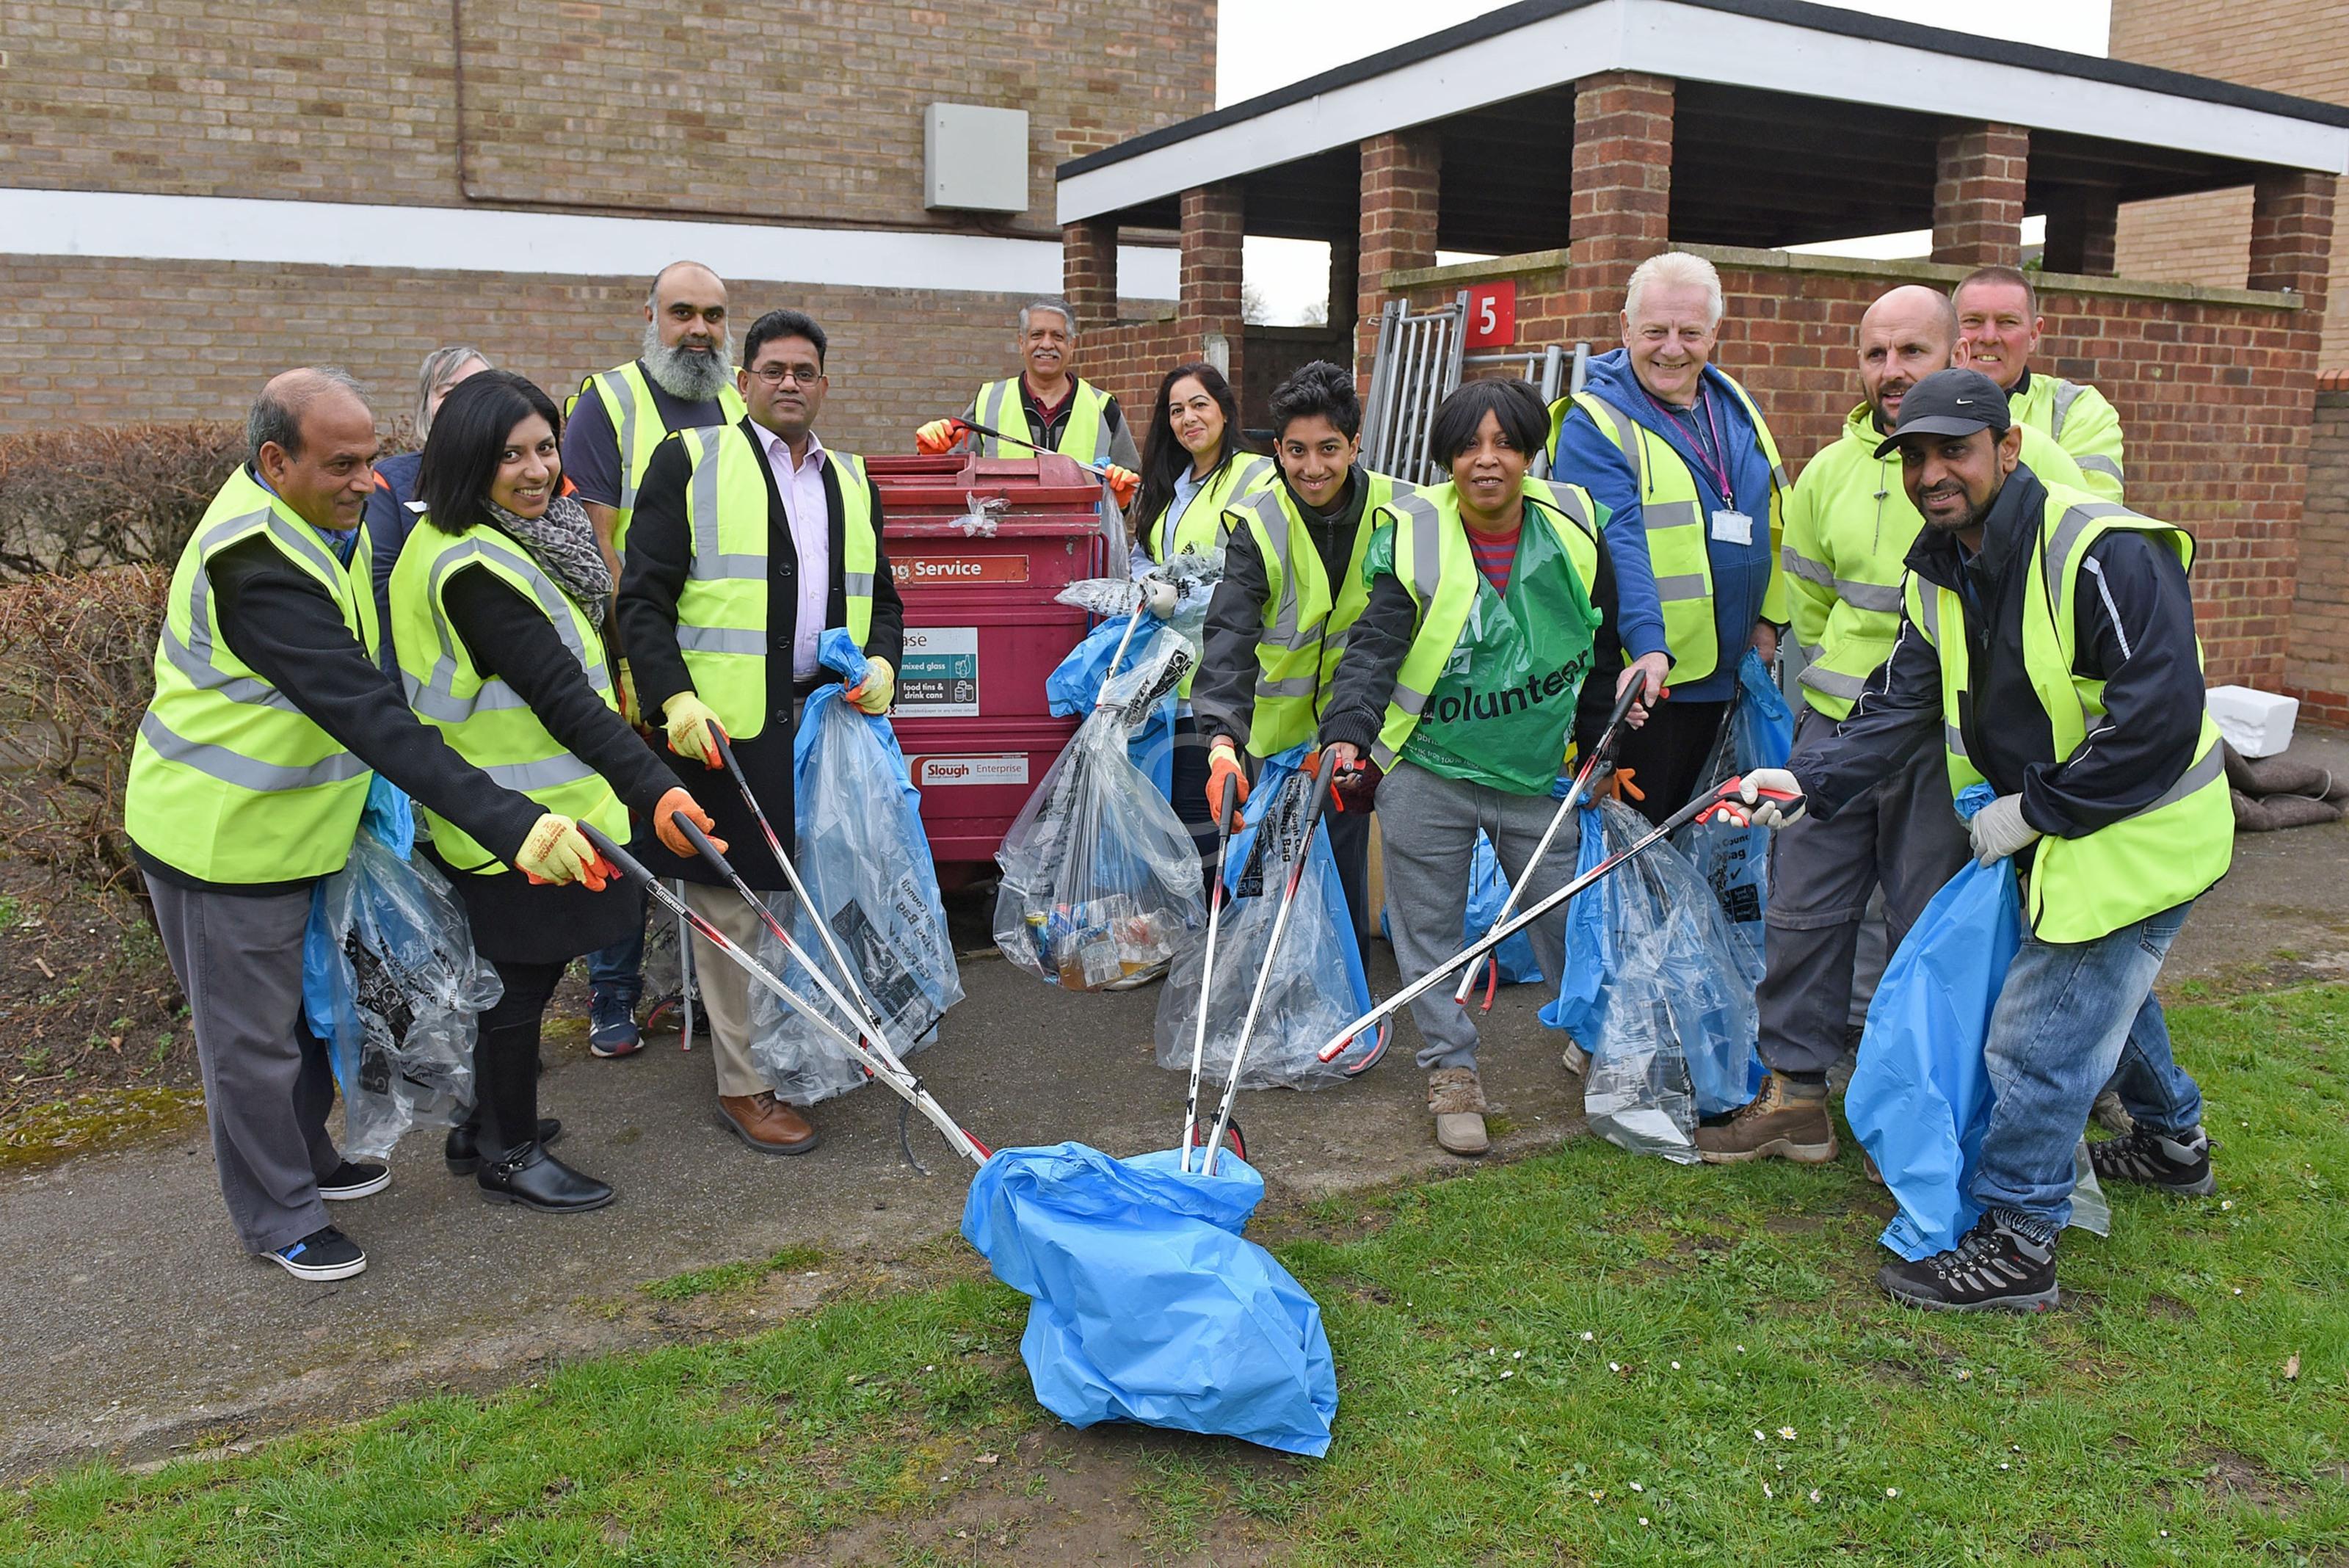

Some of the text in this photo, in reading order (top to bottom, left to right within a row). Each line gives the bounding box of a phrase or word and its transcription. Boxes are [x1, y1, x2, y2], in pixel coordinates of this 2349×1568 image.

[1479, 296, 1496, 335] 5
[890, 560, 982, 579] ng Service
[903, 636, 927, 647] ase
[901, 662, 946, 672] mixed glass
[903, 683, 944, 691] food tins &
[904, 691, 924, 700] drink
[928, 763, 1022, 777] Slough Enterprise
[1282, 838, 1291, 862] Bag
